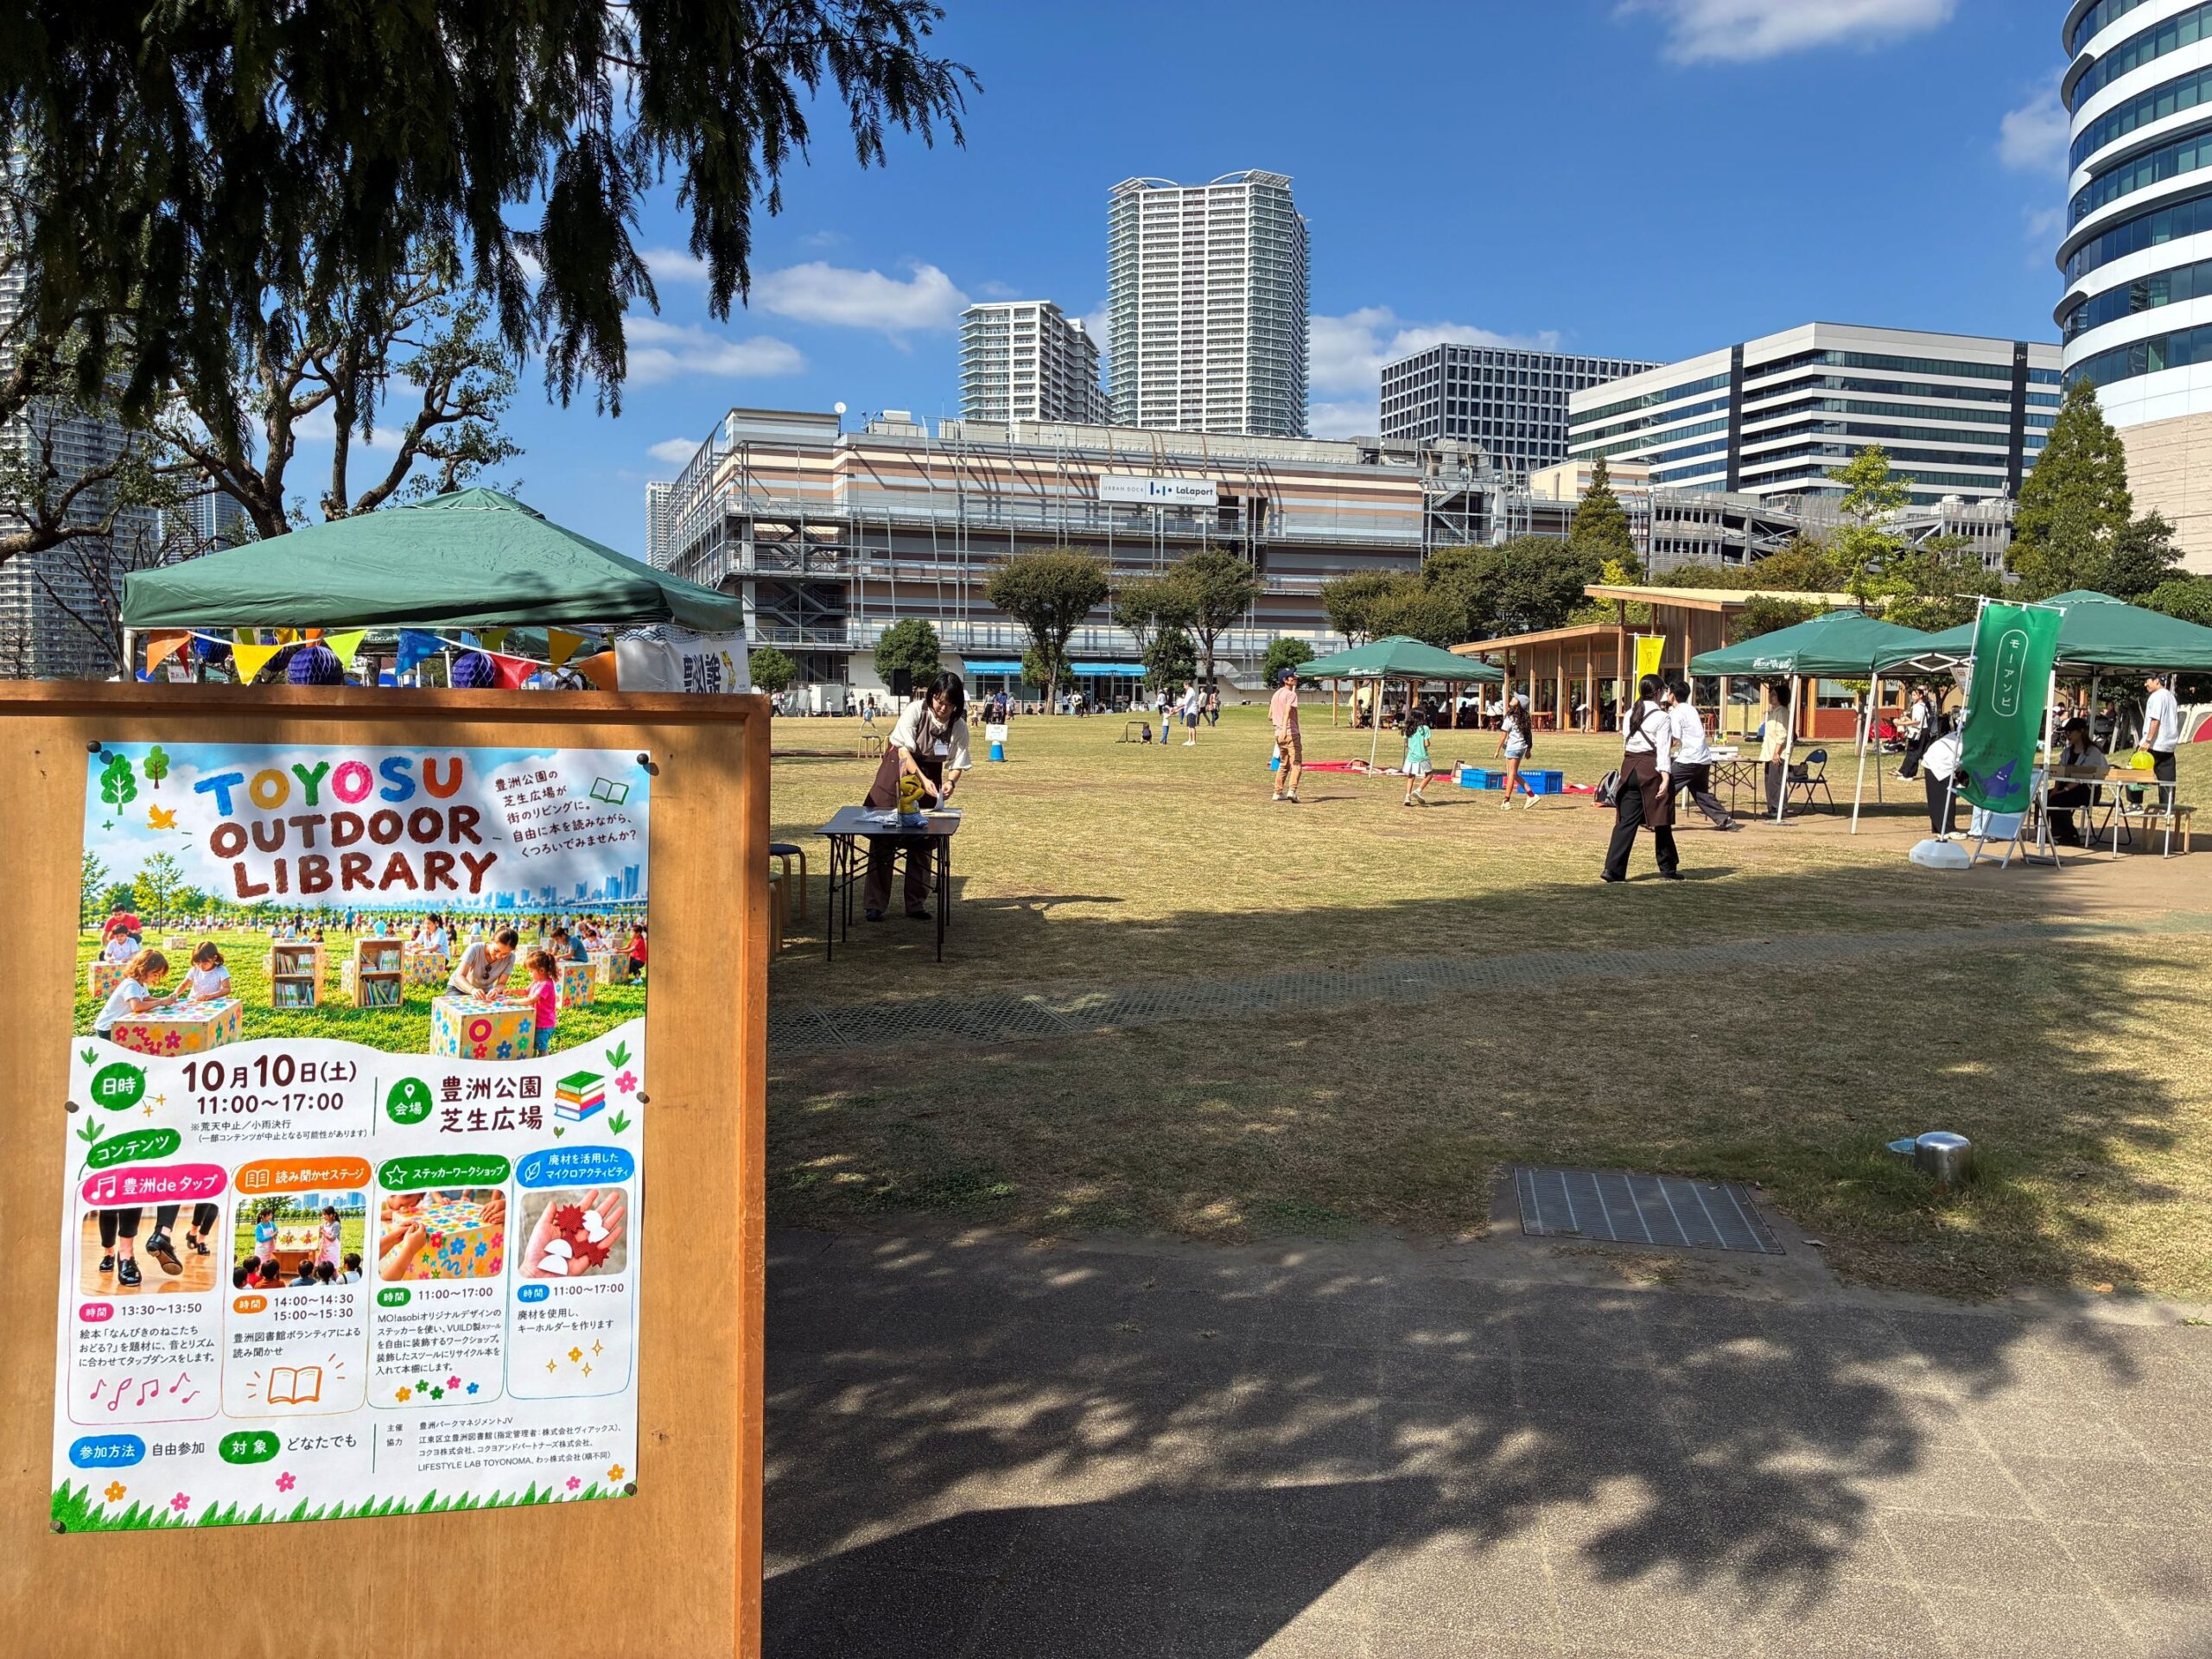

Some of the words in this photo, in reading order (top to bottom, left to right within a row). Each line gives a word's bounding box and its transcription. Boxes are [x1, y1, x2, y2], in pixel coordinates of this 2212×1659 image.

[1176, 486, 1213, 497] LaLaport
[194, 756, 464, 817] TOYOSU
[495, 770, 558, 792] 豊洲公園の
[503, 785, 567, 808] 芝生広場が
[507, 800, 590, 825] 街のリビングに。
[210, 806, 483, 859] OUTDOOR
[513, 813, 632, 843] 自由に本を読みながら、
[232, 850, 498, 899] LIBRARY
[102, 1078, 135, 1095] 日時
[441, 1076, 542, 1103] 豊洲公園
[394, 1102, 423, 1116] 会場
[440, 1106, 543, 1133] 芝生広場
[97, 1135, 170, 1161] コンテンツ
[549, 1153, 619, 1166] 廃材を活用した
[275, 1167, 365, 1184] 読み聞かせステージ
[412, 1165, 505, 1180] ステッカーワークショップ
[545, 1166, 629, 1180] マイクロアクティビティ
[122, 1173, 218, 1197] 豊洲deタップ
[384, 1292, 404, 1302] 時間
[523, 1287, 543, 1299] 時間
[86, 1306, 107, 1318] 時間
[238, 1299, 261, 1310] 時間
[518, 1307, 580, 1320] 廃材を使用し、
[79, 1325, 199, 1340] 絵本「なんびきのねこたち
[518, 1319, 614, 1333] キーホルダーを作ります
[233, 1328, 361, 1344] 豊洲図書館ボランティアによる
[377, 1334, 500, 1350] を自由に装飾するワークショップ。
[79, 1352, 215, 1368] に合わせてタップダンスをします。
[232, 1346, 283, 1359] 読み聞かせ
[376, 1347, 500, 1363] 装飾したスツールにリサイクル本を
[387, 1423, 404, 1433] 主催
[419, 1416, 513, 1430] 豊洲パークマネジメントJV
[152, 1441, 205, 1457] 自由参加
[287, 1434, 357, 1452] どなたでも
[386, 1437, 404, 1447] 協力
[79, 1443, 136, 1459] 参加方法
[417, 1460, 462, 1471] LIFESTYLE
[464, 1459, 481, 1468] LAB
